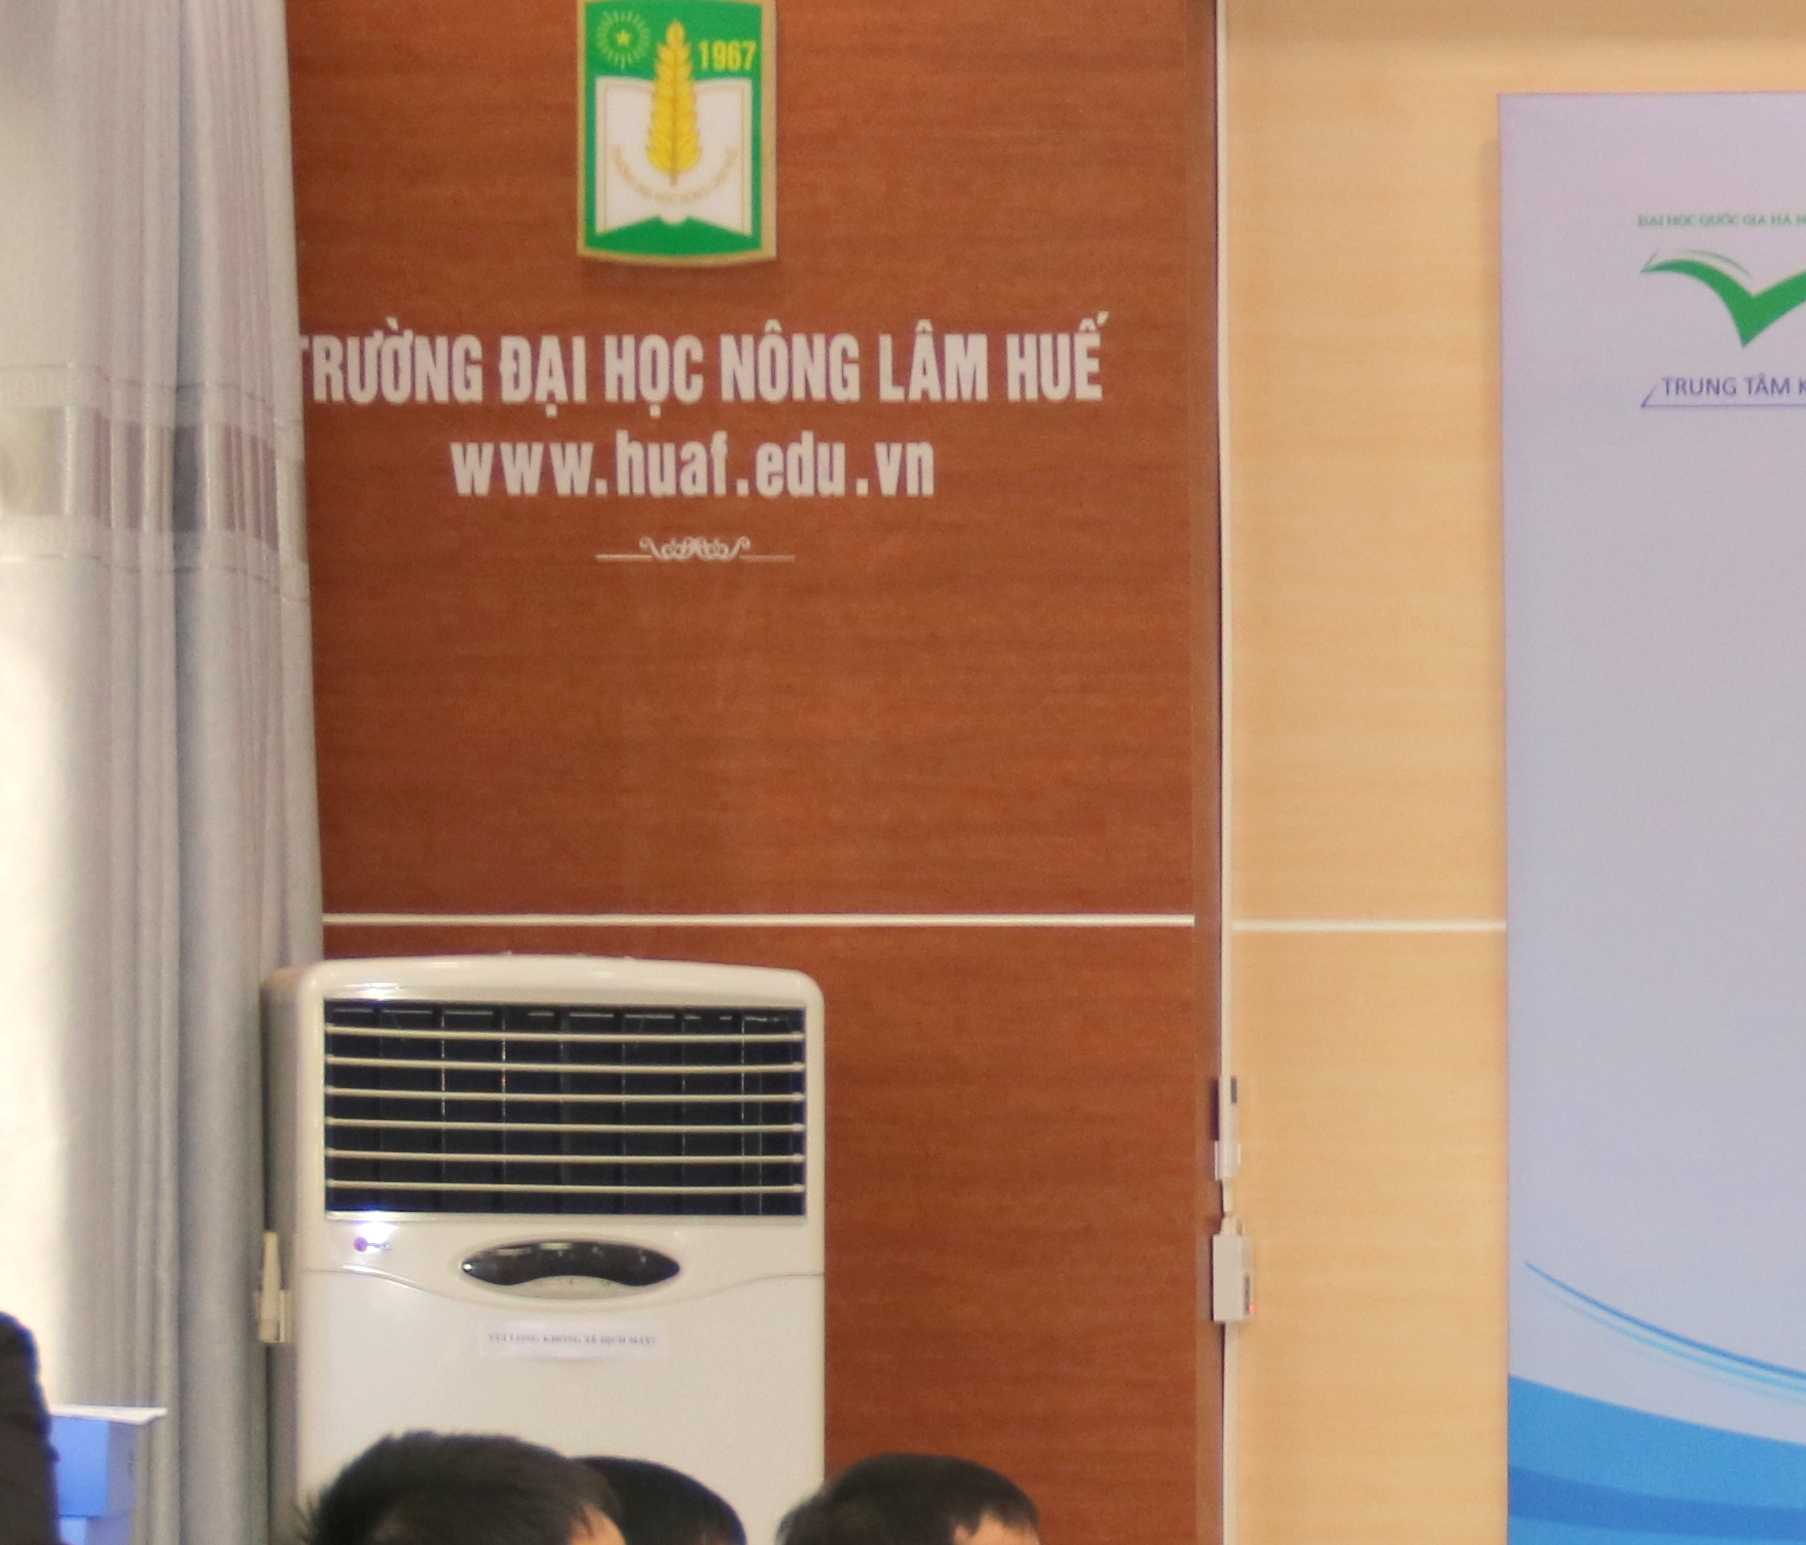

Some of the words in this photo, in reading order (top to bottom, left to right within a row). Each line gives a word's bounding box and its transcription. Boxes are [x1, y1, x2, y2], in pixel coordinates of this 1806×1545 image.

[698, 39, 757, 72] 1967
[499, 334, 586, 417] ĐẠI
[604, 334, 704, 417] HỌC
[720, 318, 860, 403] NÔNG
[879, 318, 988, 402] LÂM
[1006, 311, 1109, 402] HUẾ
[1662, 376, 1738, 397] TRUNG
[1743, 371, 1790, 395] TÂM
